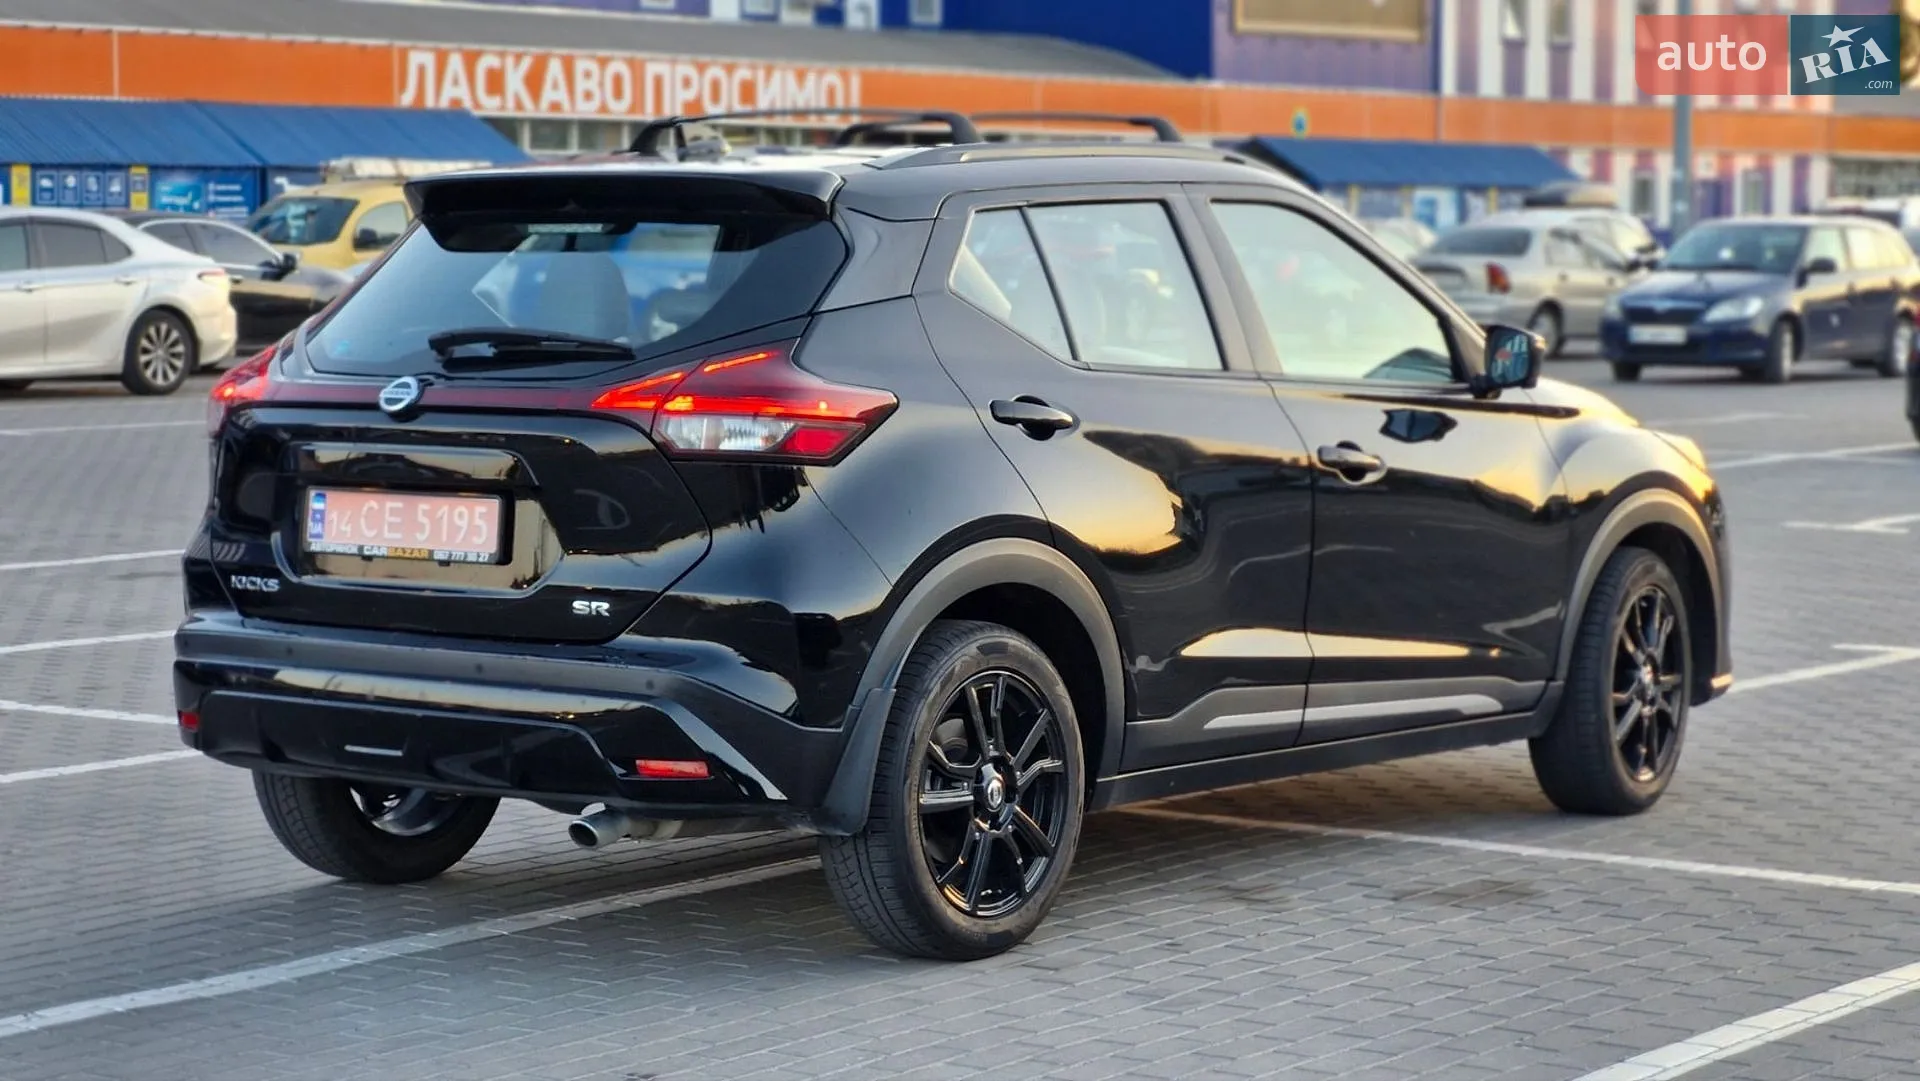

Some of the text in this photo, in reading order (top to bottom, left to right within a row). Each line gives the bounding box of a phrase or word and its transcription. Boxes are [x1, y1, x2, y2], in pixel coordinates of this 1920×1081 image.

[399, 50, 861, 123] ЛАСКАВО ПРОСИМО!
[328, 509, 353, 539] 14
[360, 499, 404, 540] CE
[416, 503, 489, 546] 5195
[231, 575, 280, 592] KICKS
[572, 600, 610, 616] SR
